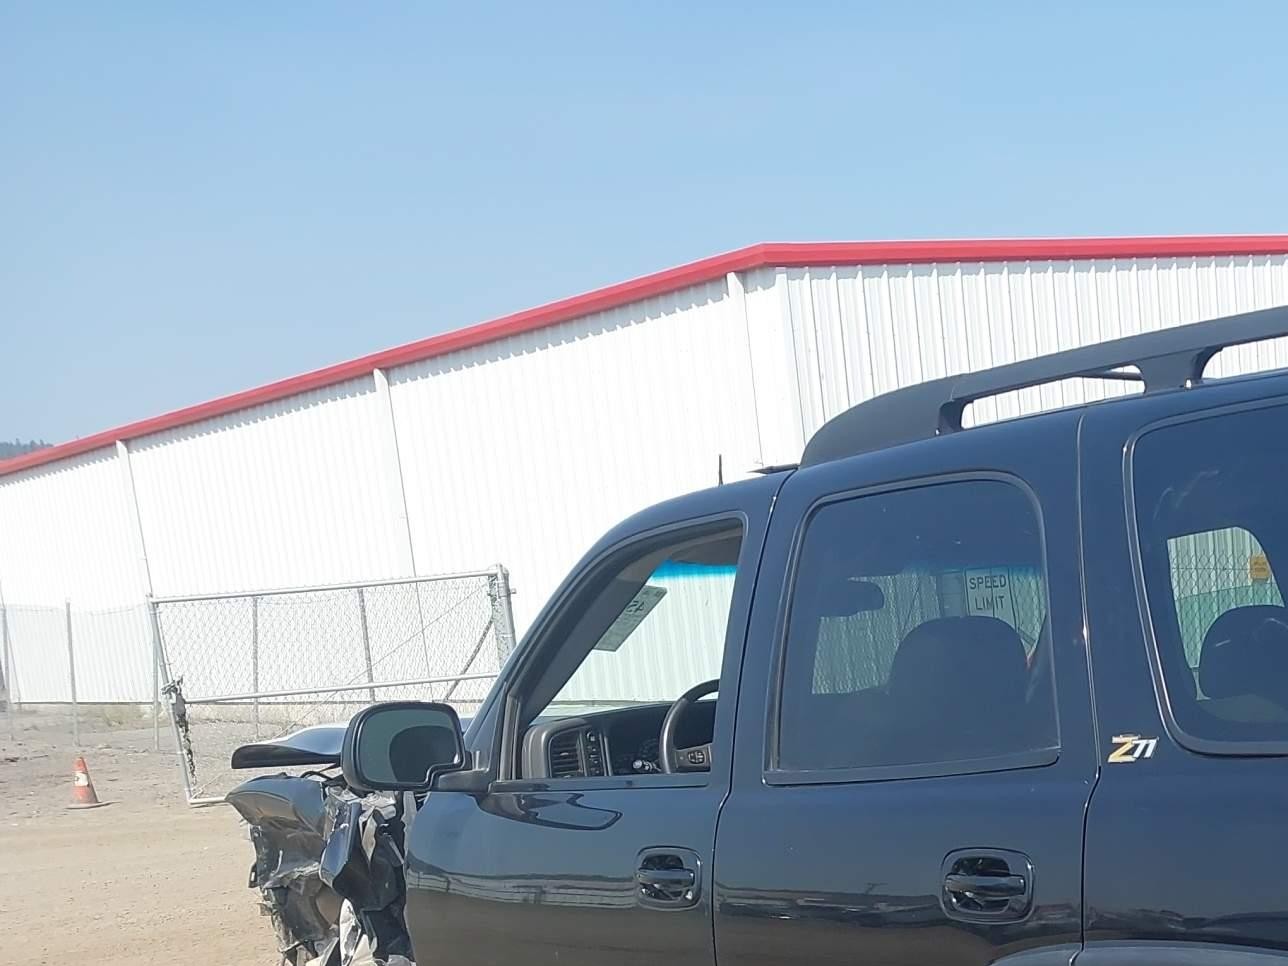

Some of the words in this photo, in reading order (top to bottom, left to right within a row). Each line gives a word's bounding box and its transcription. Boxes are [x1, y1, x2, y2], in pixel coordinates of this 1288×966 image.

[969, 575, 1006, 590] SPEED
[975, 596, 1004, 610] LIMIT
[1107, 734, 1159, 763] Z71
